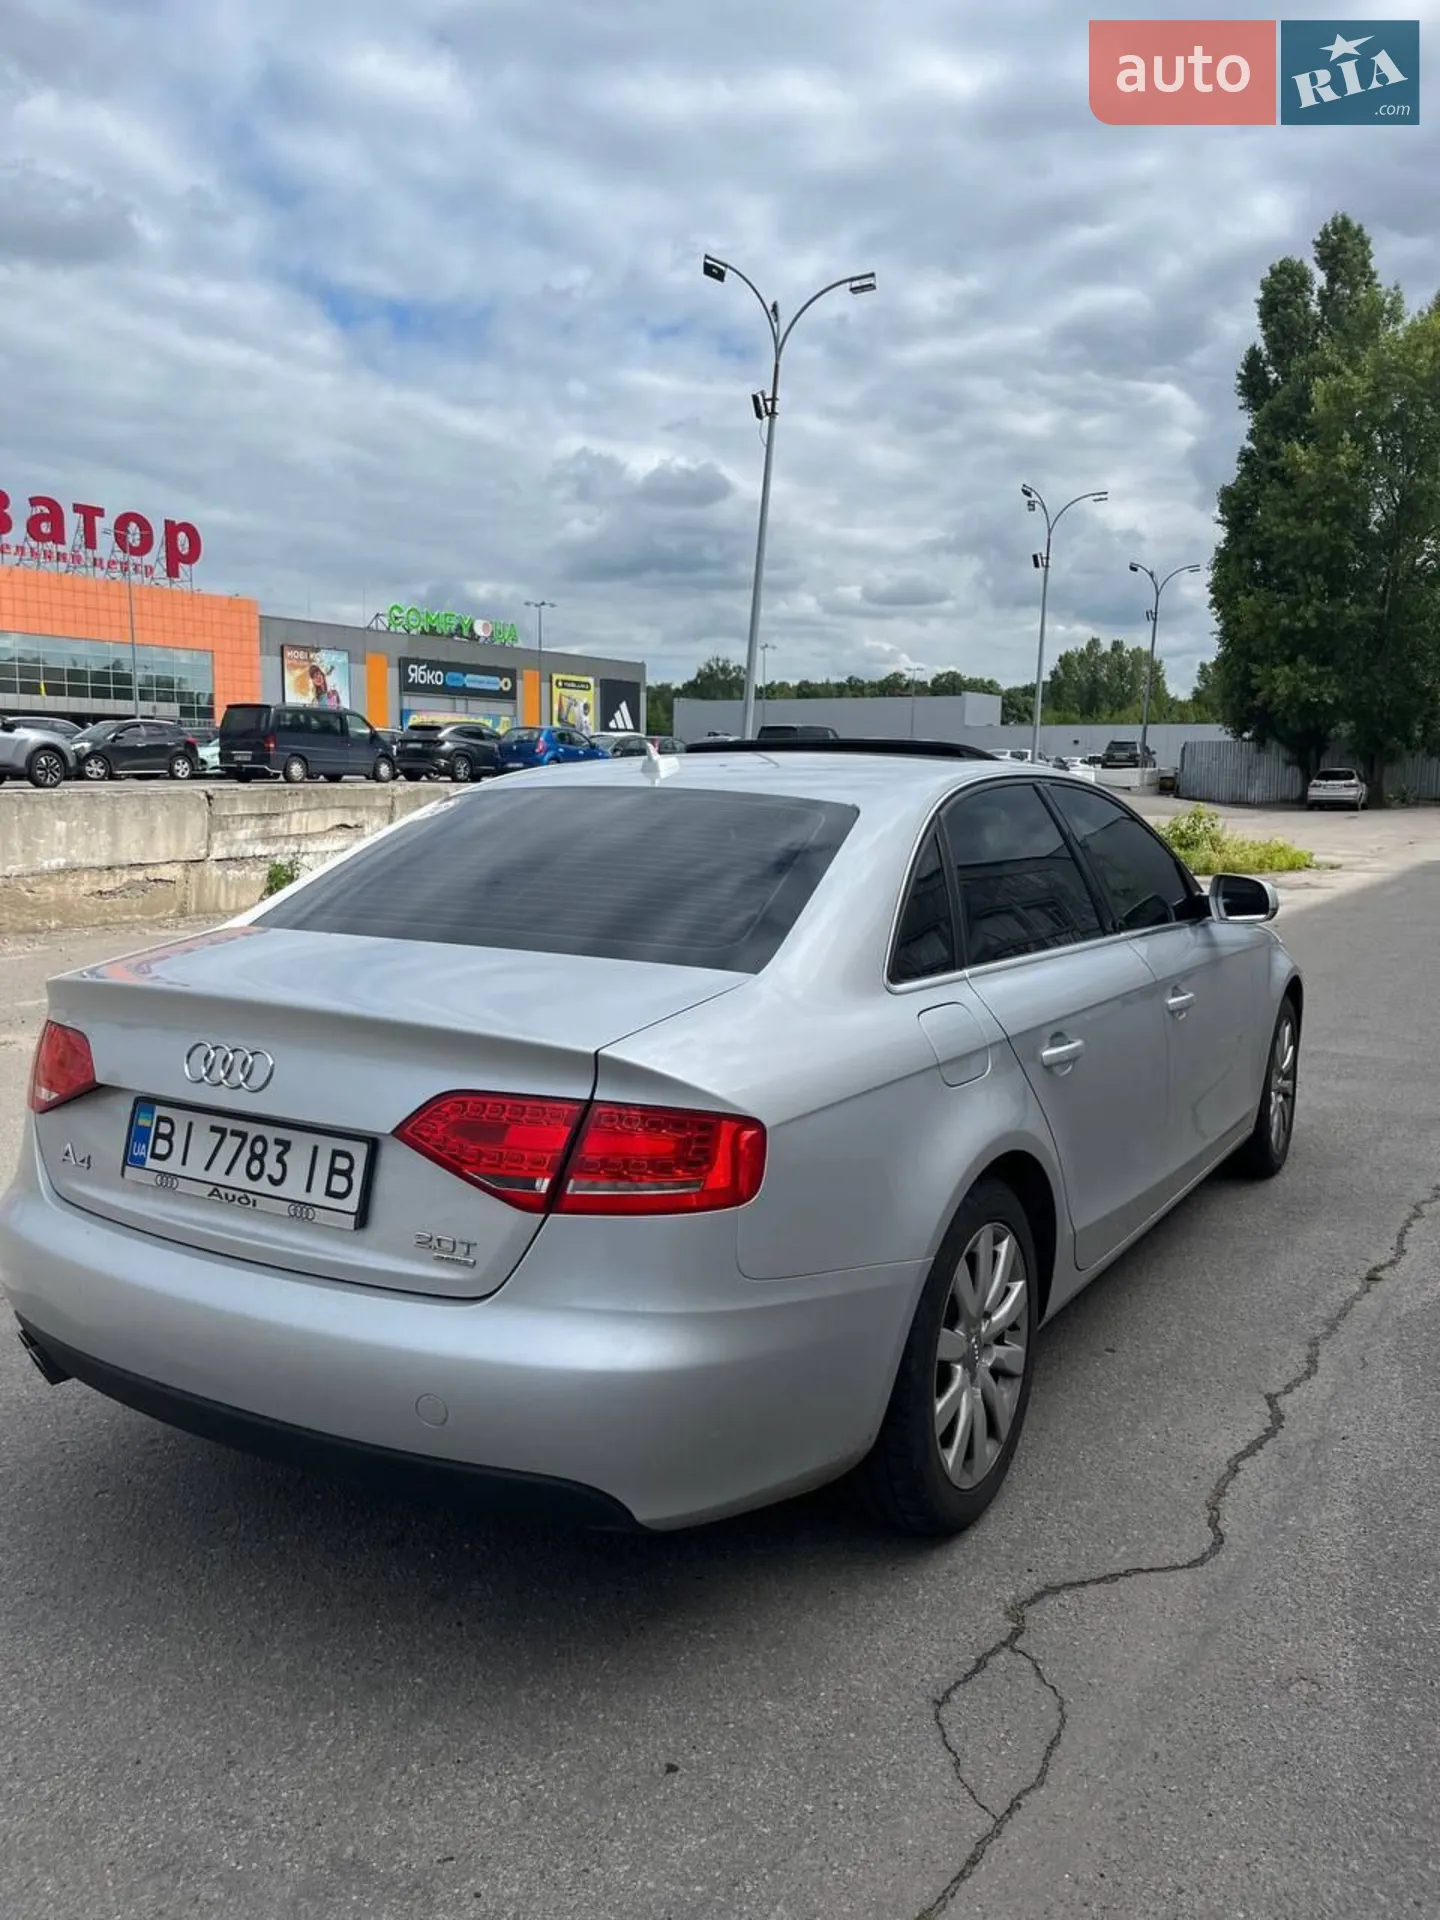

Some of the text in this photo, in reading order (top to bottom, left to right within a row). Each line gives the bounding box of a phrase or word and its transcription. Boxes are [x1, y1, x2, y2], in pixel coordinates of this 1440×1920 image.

[388, 604, 475, 637] COMFY
[408, 664, 444, 686] Ябко
[62, 1141, 93, 1171] A4
[132, 1142, 147, 1158] UA
[149, 1115, 355, 1201] BI 7783 IB
[207, 1186, 257, 1208] Audi
